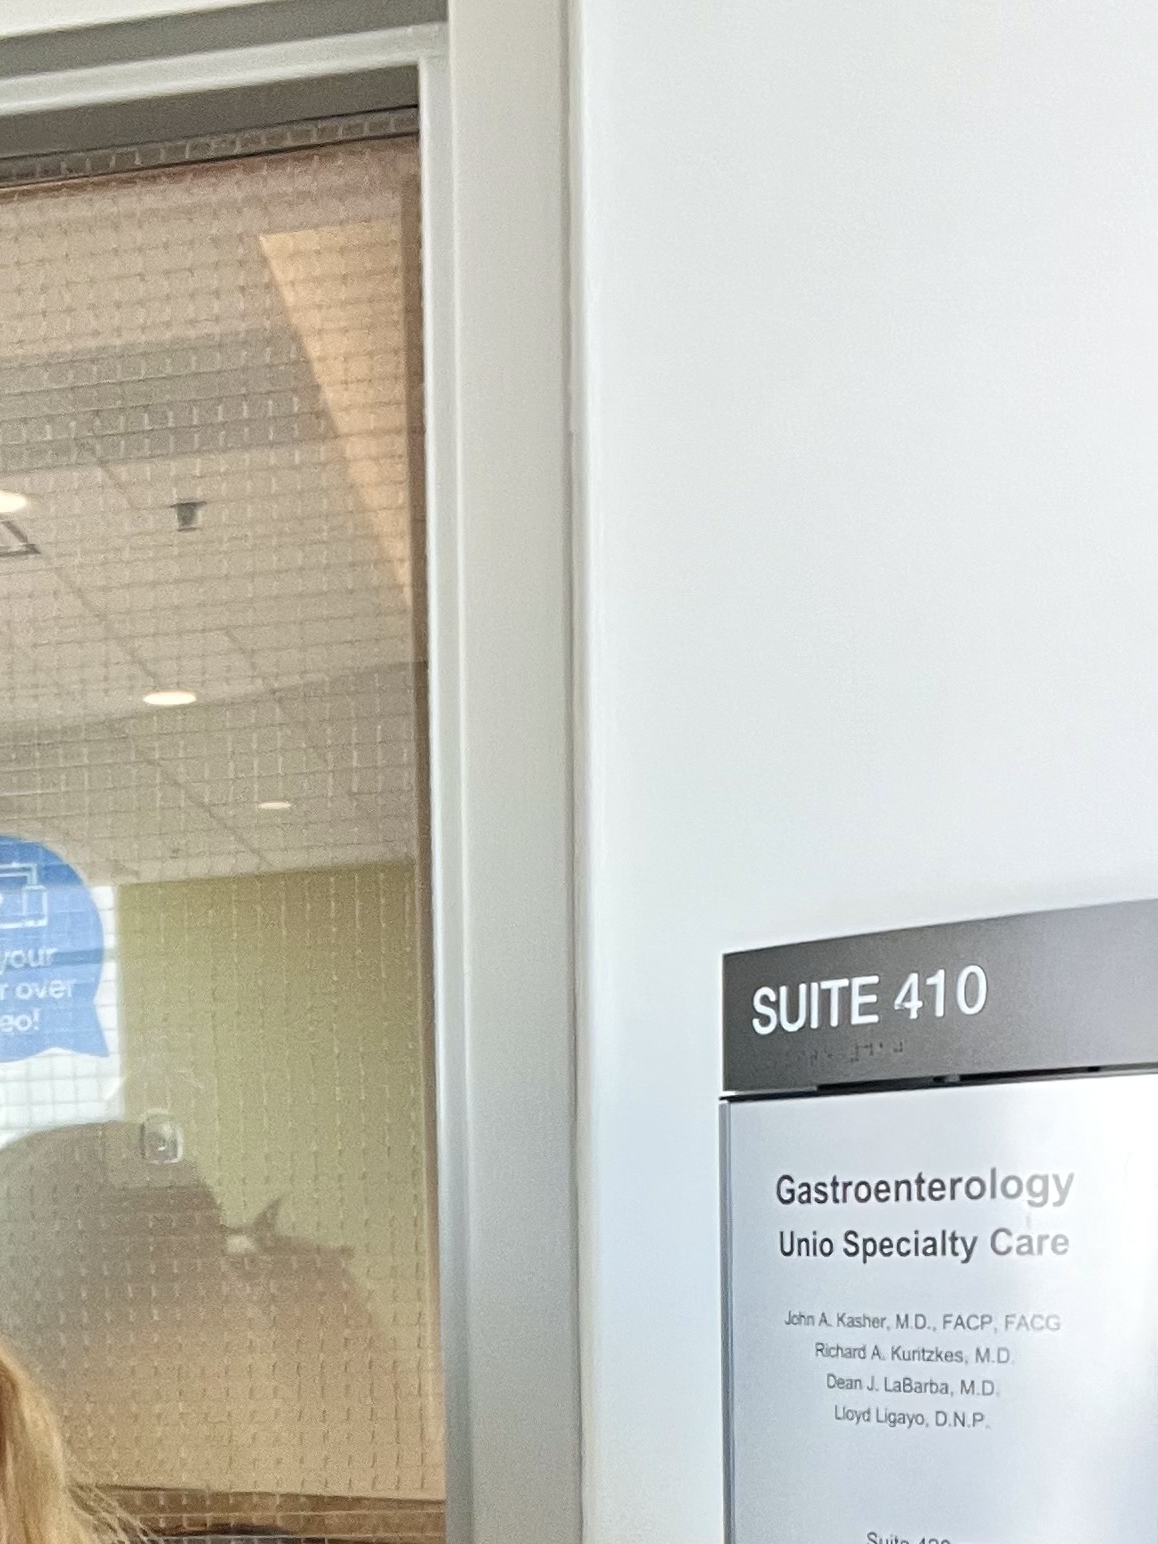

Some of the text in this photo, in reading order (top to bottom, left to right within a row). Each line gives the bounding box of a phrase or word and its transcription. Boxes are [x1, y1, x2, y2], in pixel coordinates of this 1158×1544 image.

[15, 979, 76, 1001] over
[752, 964, 987, 1035] SUITE 410
[776, 1167, 1075, 1207] Gastroenterology
[779, 1227, 1070, 1264] Unio Specialty Care
[785, 1310, 1061, 1334] John A. Kasher, M.D., FACP, FACG
[815, 1342, 1015, 1366] Richard A. Kuntzkes, M.D.
[826, 1373, 1001, 1397] Dean J. LaBarba, M.D.
[834, 1405, 991, 1430] Lloyd Ligayo, D.N.P.
